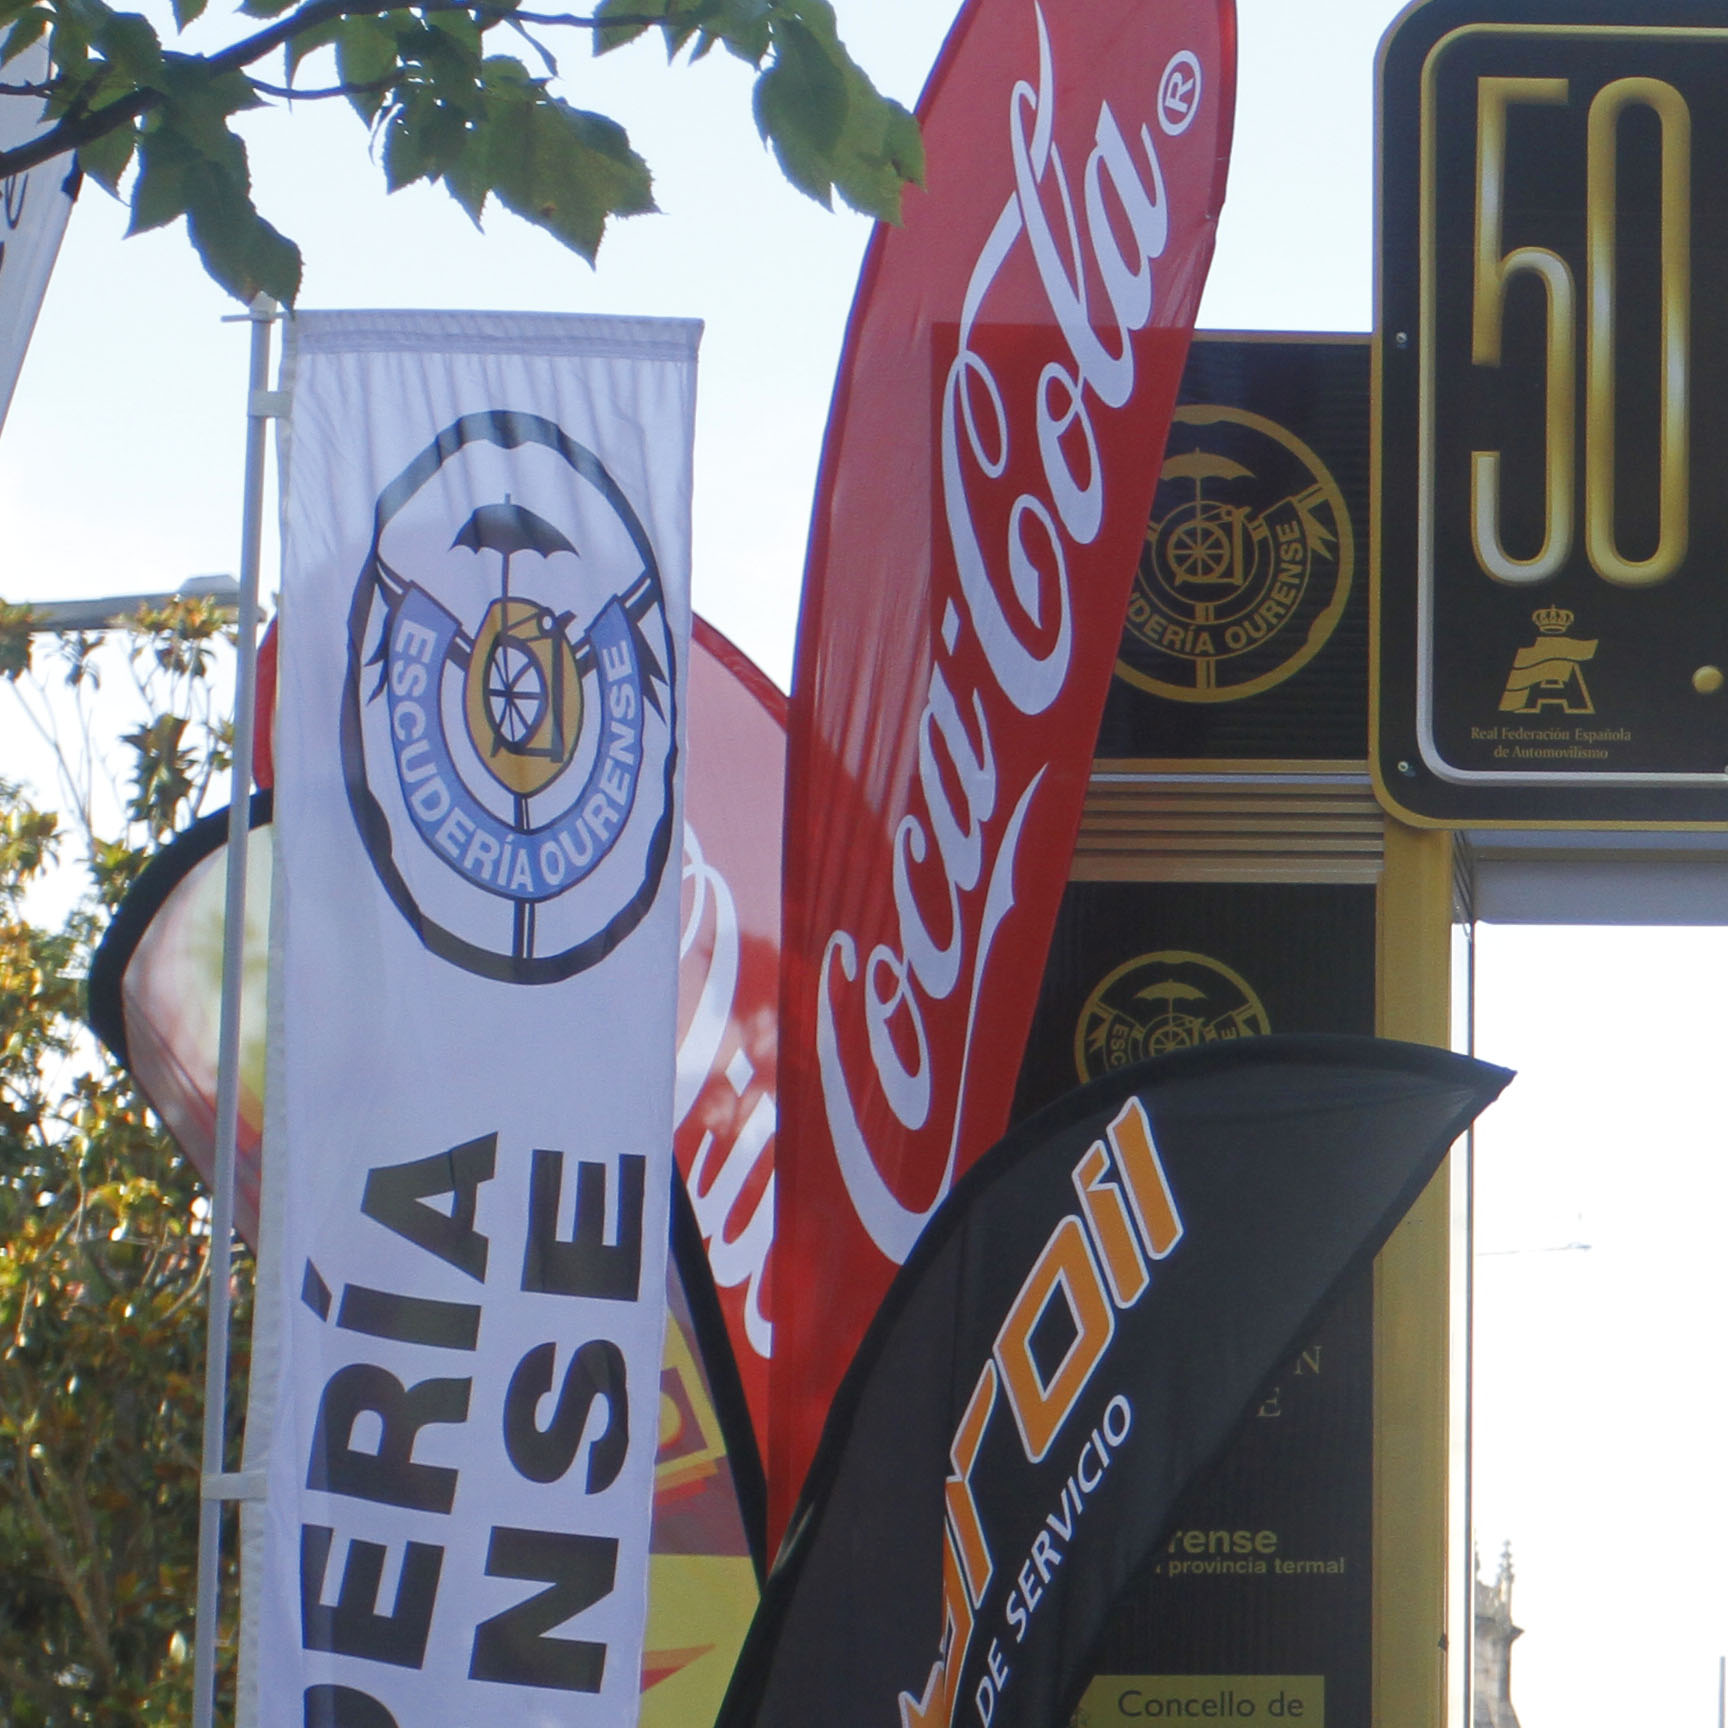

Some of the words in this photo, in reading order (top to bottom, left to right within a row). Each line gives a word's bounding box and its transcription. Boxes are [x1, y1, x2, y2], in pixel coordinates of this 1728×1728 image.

[1470, 77, 1690, 588] 50
[1127, 591, 1215, 655] DERÍA
[1224, 518, 1304, 651] OURENSE
[1471, 726, 1498, 741] Real
[1501, 726, 1570, 741] Federación
[1574, 727, 1632, 744] Española
[389, 617, 533, 893] ESCUDERÍA
[539, 636, 637, 887] OURENSE
[1493, 745, 1511, 759] de
[1512, 745, 1609, 760] Automovilismo
[1005, 1394, 1133, 1645] SERVICIO
[1168, 1528, 1279, 1554] rense
[1167, 1556, 1268, 1577] provincia
[1273, 1556, 1345, 1575] termal
[1117, 1689, 1256, 1718] Concello
[1267, 1690, 1305, 1718] de
